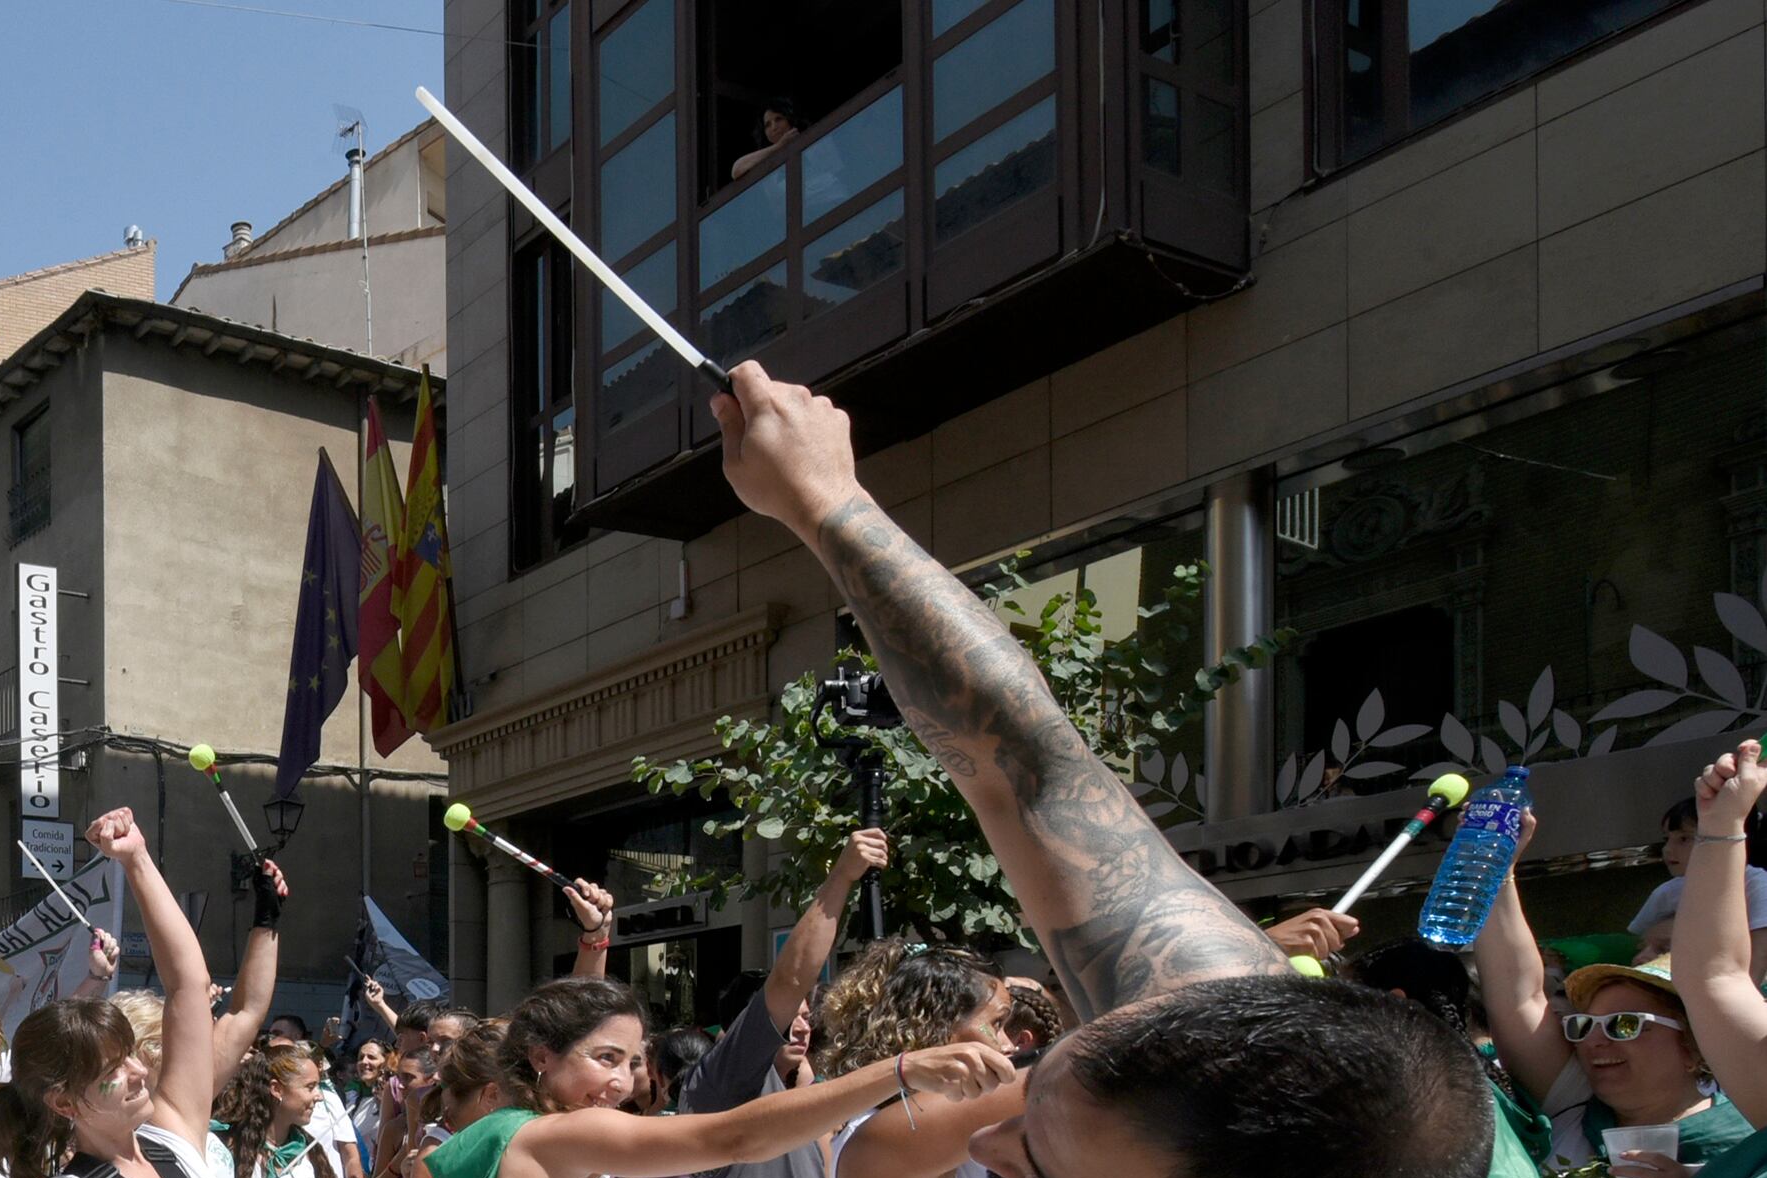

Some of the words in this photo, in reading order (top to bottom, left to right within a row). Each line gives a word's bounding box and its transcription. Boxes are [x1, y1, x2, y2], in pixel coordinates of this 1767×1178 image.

[26, 573, 50, 676] Gastro
[28, 690, 51, 809] Caserío
[24, 841, 72, 855] Tradicional
[32, 828, 65, 841] Comida
